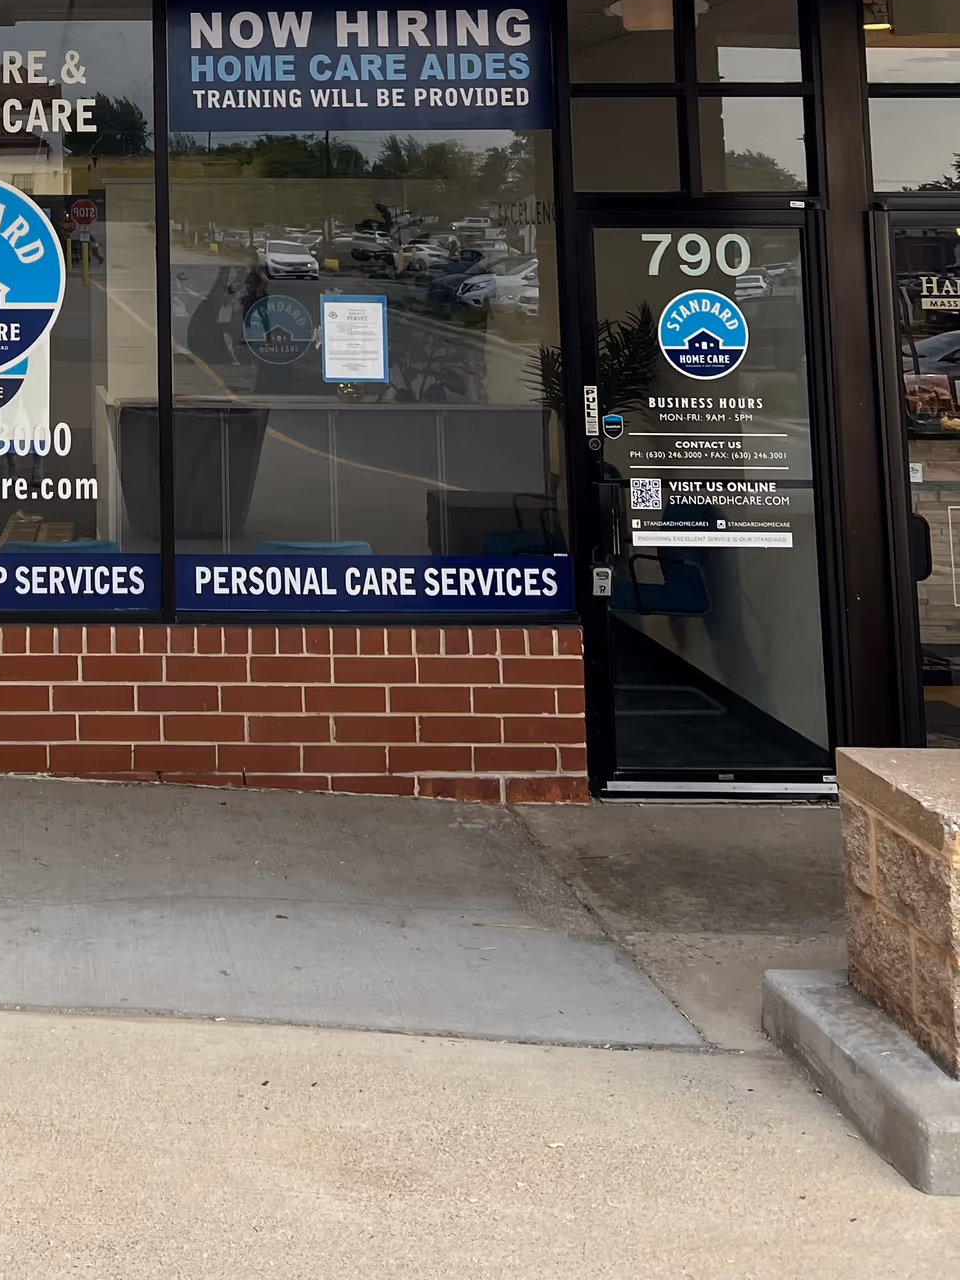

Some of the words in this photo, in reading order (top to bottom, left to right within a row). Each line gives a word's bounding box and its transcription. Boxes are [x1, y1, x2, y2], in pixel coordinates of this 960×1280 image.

[190, 10, 313, 49] NOW
[336, 8, 532, 48] HIRING
[60, 50, 87, 84] &
[191, 54, 296, 83] HOME
[308, 53, 407, 82] CARE
[420, 53, 530, 81] AIDES
[193, 89, 302, 109] TRAINING
[310, 88, 368, 108] WILL
[377, 88, 406, 108] BE
[414, 87, 530, 107] PROVIDED
[2, 98, 97, 133] CARE
[641, 233, 751, 276] 790
[250, 301, 307, 327] STANDARD
[666, 298, 739, 331] STANDARD
[259, 344, 278, 352] HOME
[281, 344, 299, 352] CARE
[679, 354, 705, 364] HOME
[707, 354, 730, 364] CARE
[586, 389, 597, 419] PULL
[648, 397, 714, 409] BUSINESS
[719, 397, 764, 410] HOURS
[659, 413, 703, 422] MON-FRI:
[705, 413, 727, 422] 9AM
[735, 414, 753, 422] 5PM
[645, 451, 666, 459] (630)
[668, 451, 702, 459] 246.3000
[731, 452, 751, 460] (630)
[675, 441, 725, 449] CONTACT
[728, 441, 741, 449] US
[669, 481, 702, 492] VISIT
[706, 481, 723, 492] US
[727, 482, 776, 493] ONLINE
[669, 495, 790, 506] STANDARDHCARE.COM
[15, 564, 145, 595] SERVICES
[195, 566, 337, 595] PERSONAL
[345, 566, 417, 596] CARE
[424, 567, 558, 597] SERVICES
